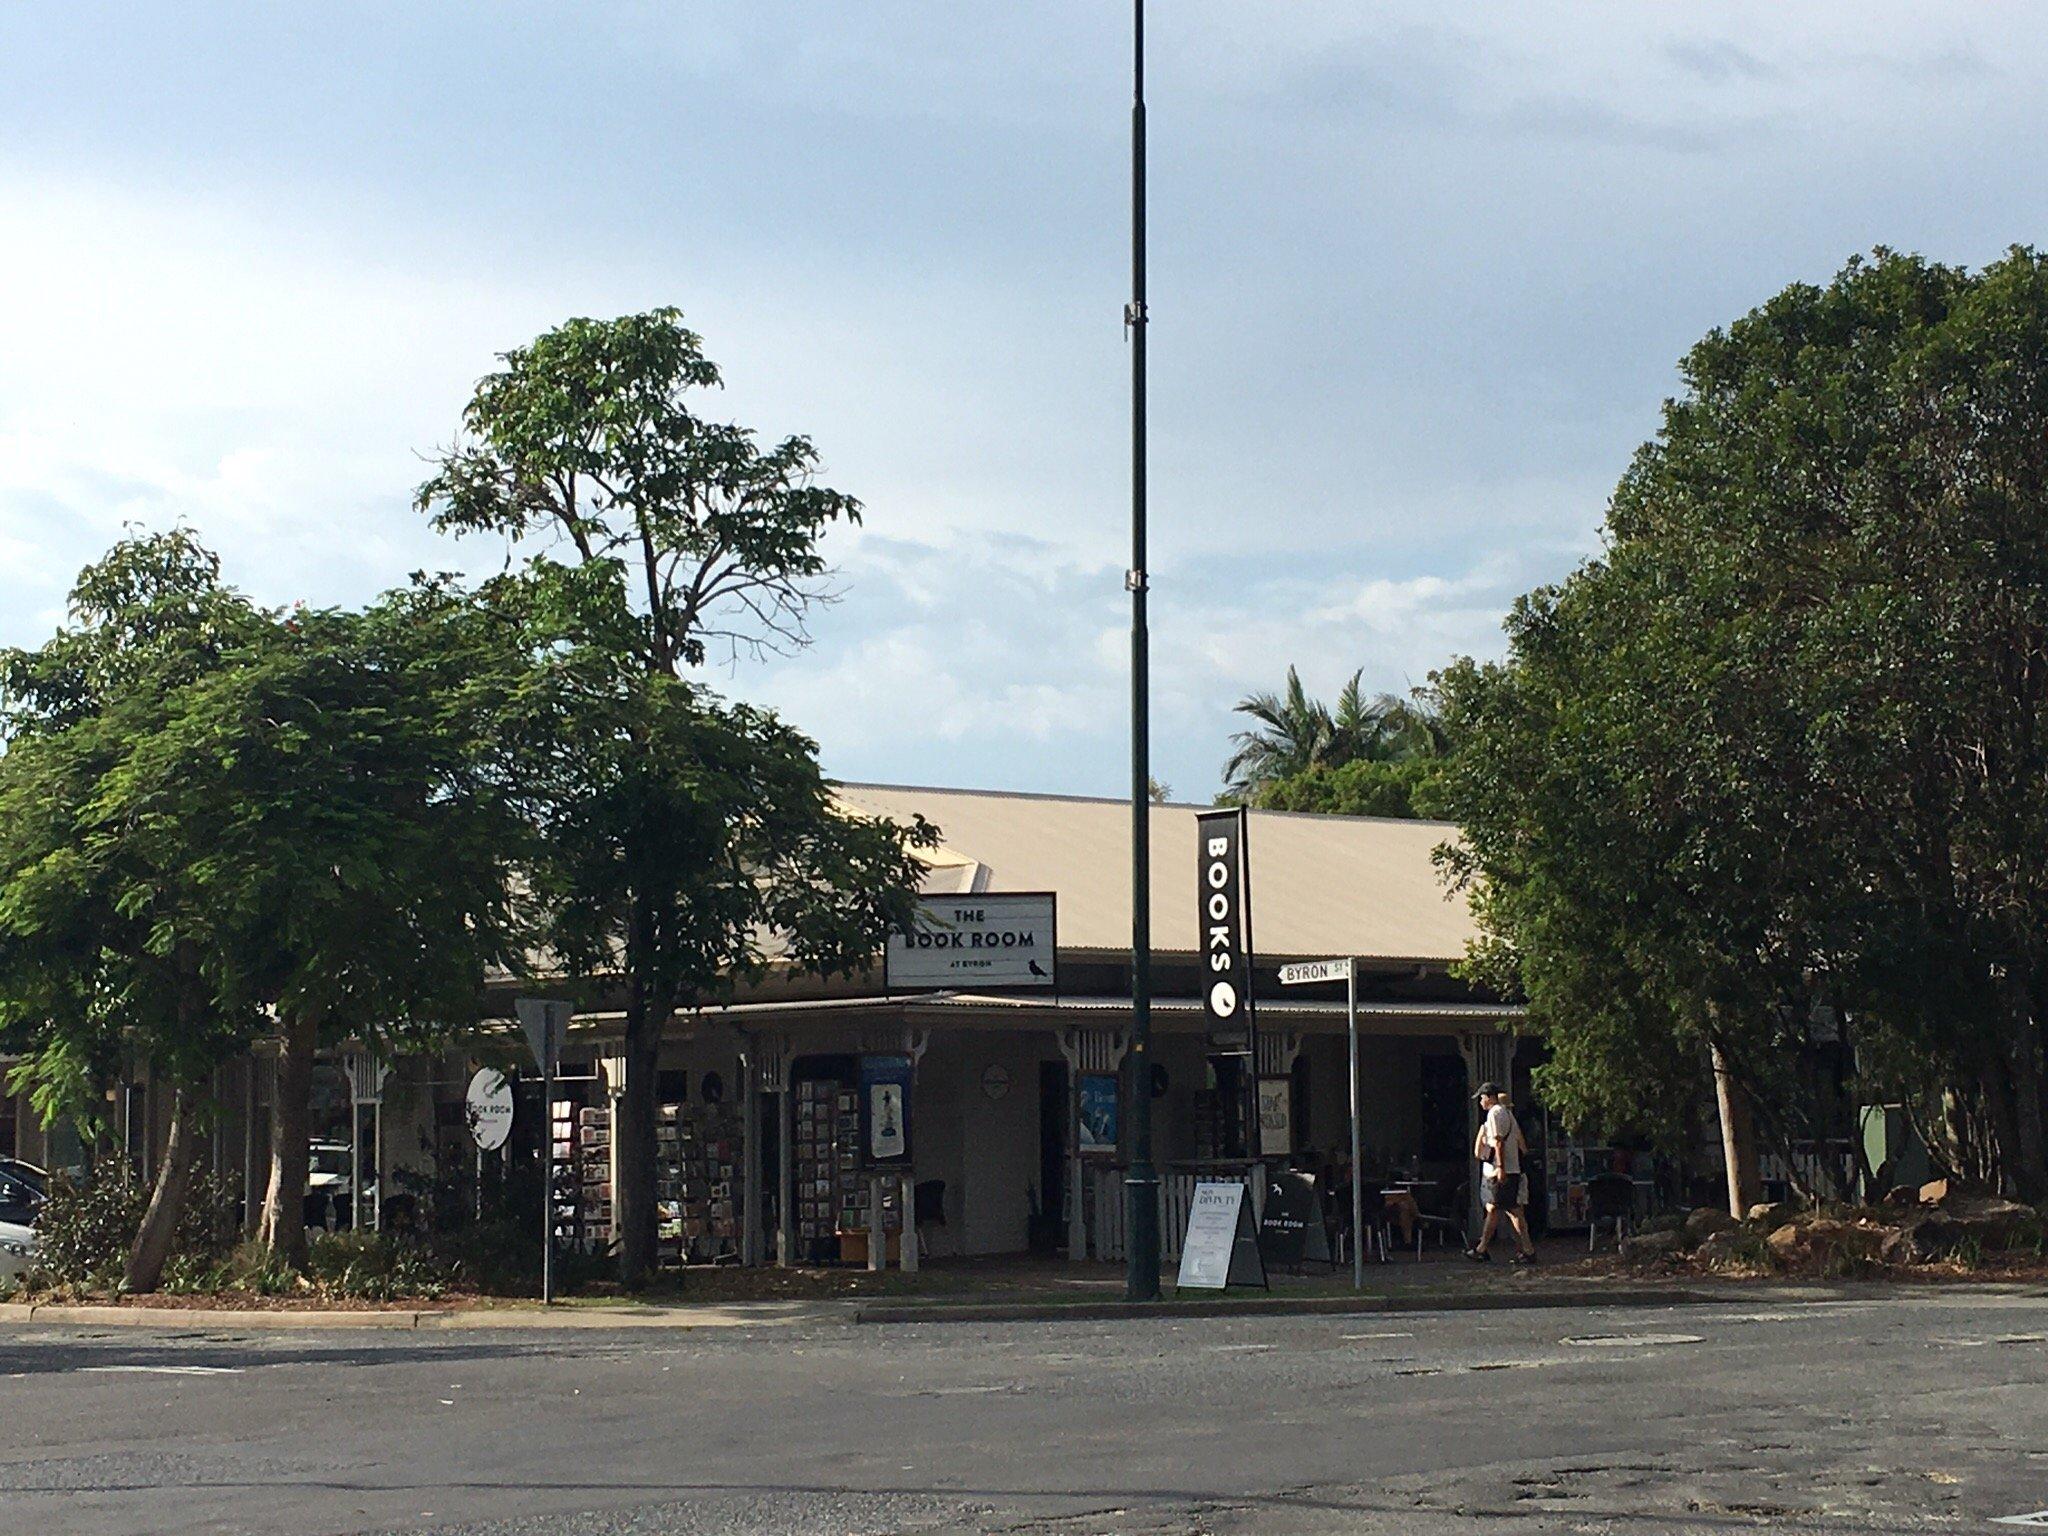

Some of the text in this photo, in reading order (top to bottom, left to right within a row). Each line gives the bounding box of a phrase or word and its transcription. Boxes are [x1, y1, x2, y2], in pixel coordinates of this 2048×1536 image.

[1208, 837, 1231, 971] BOOKS
[954, 910, 985, 922] THE
[972, 931, 1034, 947] ROOM
[962, 959, 992, 968] BYRON
[1287, 965, 1328, 980] BYRON
